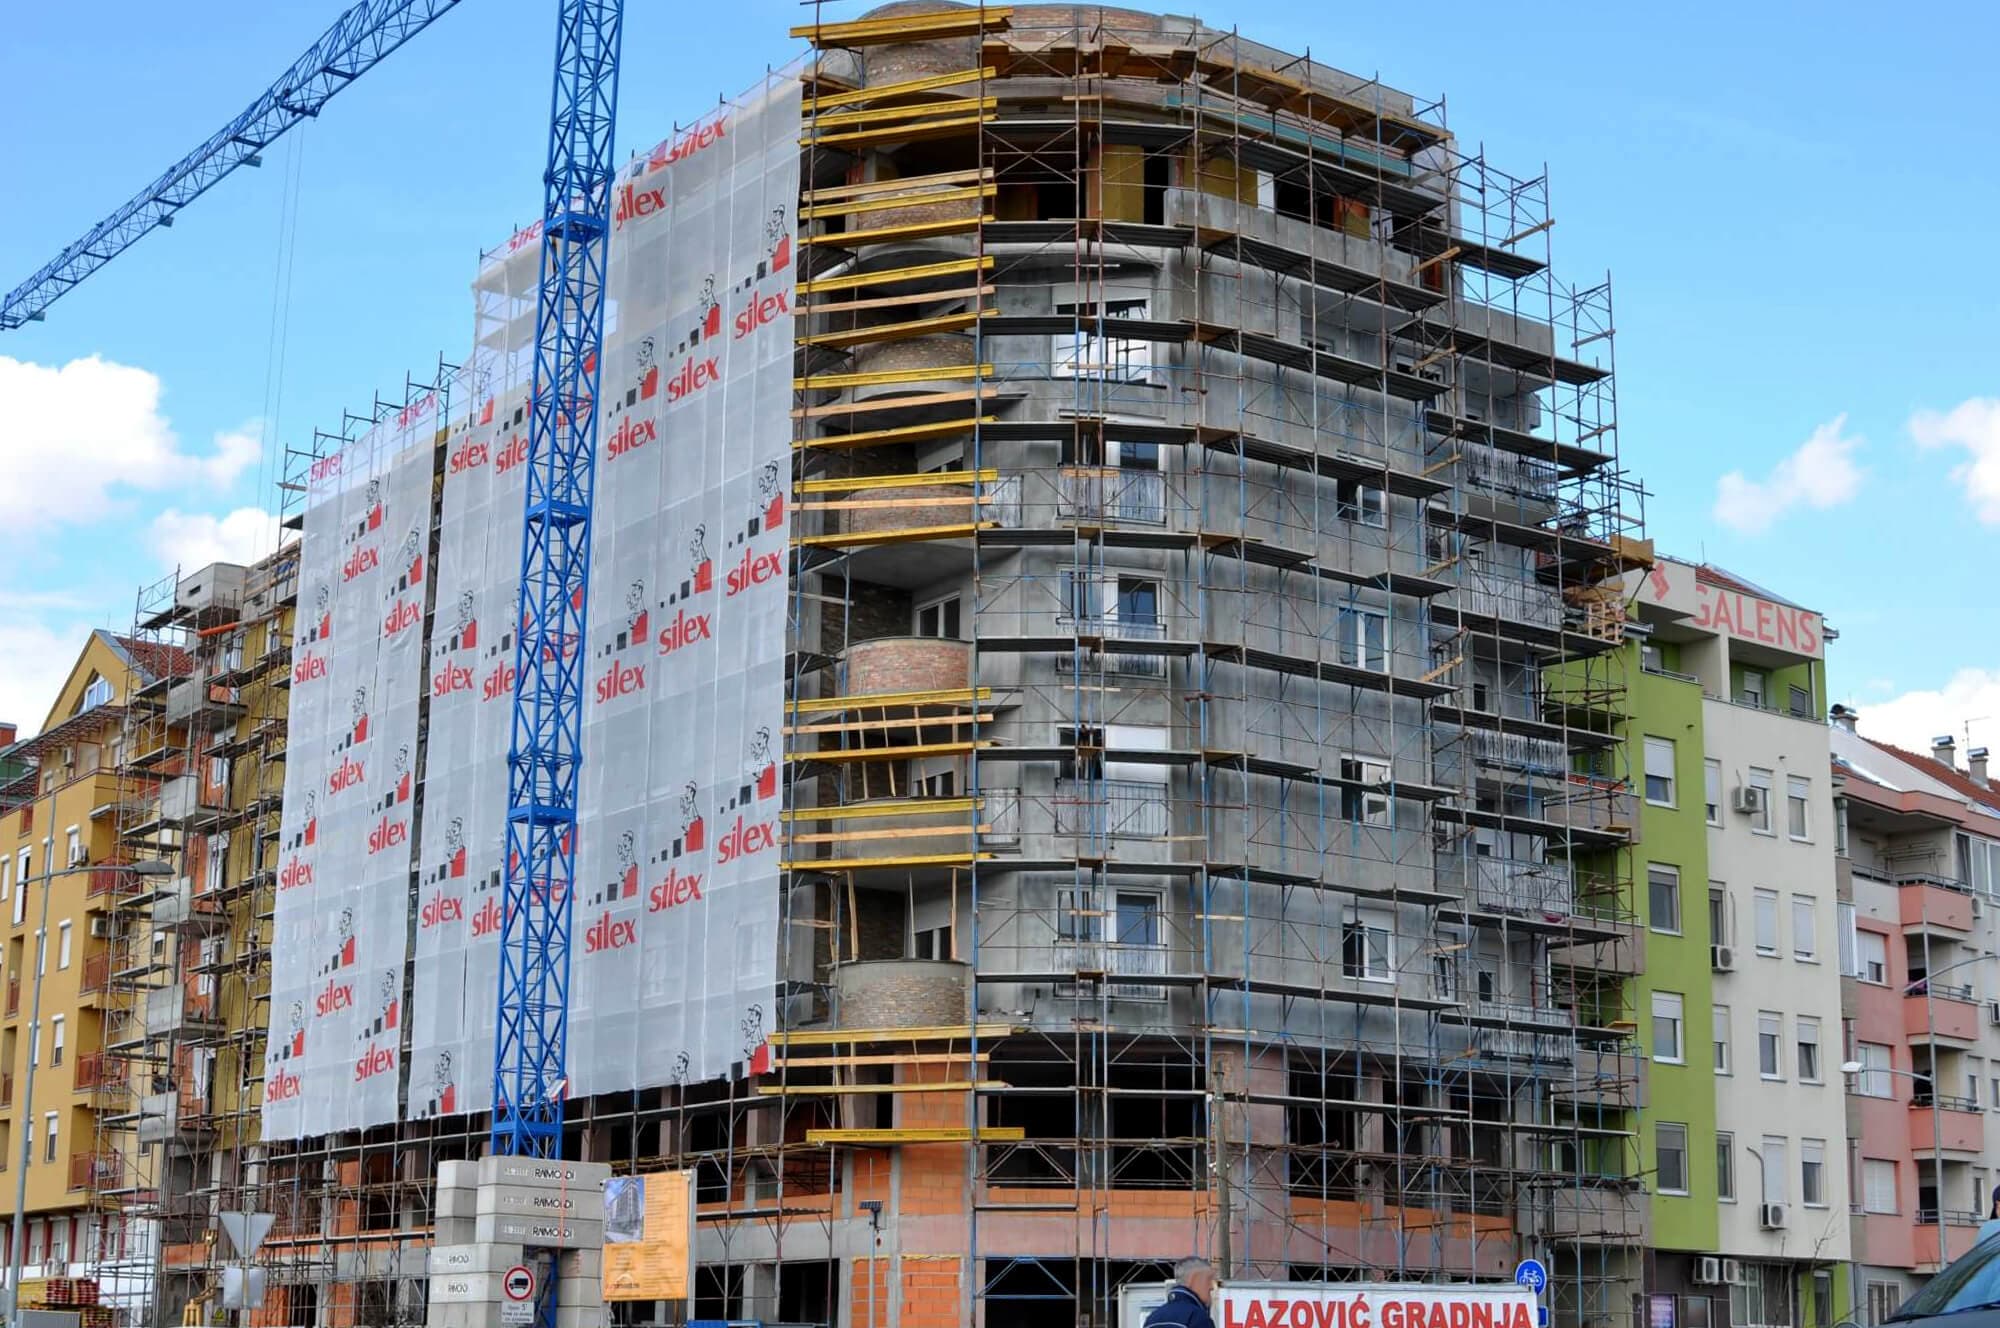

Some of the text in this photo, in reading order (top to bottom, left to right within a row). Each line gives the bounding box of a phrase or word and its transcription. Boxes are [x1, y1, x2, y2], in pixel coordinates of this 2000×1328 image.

[735, 288, 789, 339] silex
[667, 356, 720, 402] silex
[450, 436, 489, 475] silex
[496, 433, 529, 475] sile
[607, 415, 657, 461] silex
[342, 545, 379, 583] silex
[726, 547, 784, 597] silex
[384, 599, 421, 638] silex
[659, 608, 711, 655] silex
[1692, 585, 1816, 653] GALENS
[294, 649, 327, 685] silex
[433, 660, 475, 697] silex
[596, 659, 645, 704] silex
[329, 755, 365, 795] silex
[368, 815, 407, 855] silex
[717, 815, 776, 865] silex
[280, 855, 313, 891] silex
[649, 867, 702, 913] silex
[421, 890, 463, 928] silex
[585, 911, 637, 953] silex
[316, 979, 353, 1018] silex
[355, 1043, 395, 1082] silex
[267, 1068, 300, 1104] silex
[534, 1168, 575, 1180] RAIMODI
[533, 1197, 574, 1209] RAIMODI
[532, 1226, 573, 1238] RAIMODI
[1224, 1293, 1532, 1328] LAZOVIĆ GRADNJA
